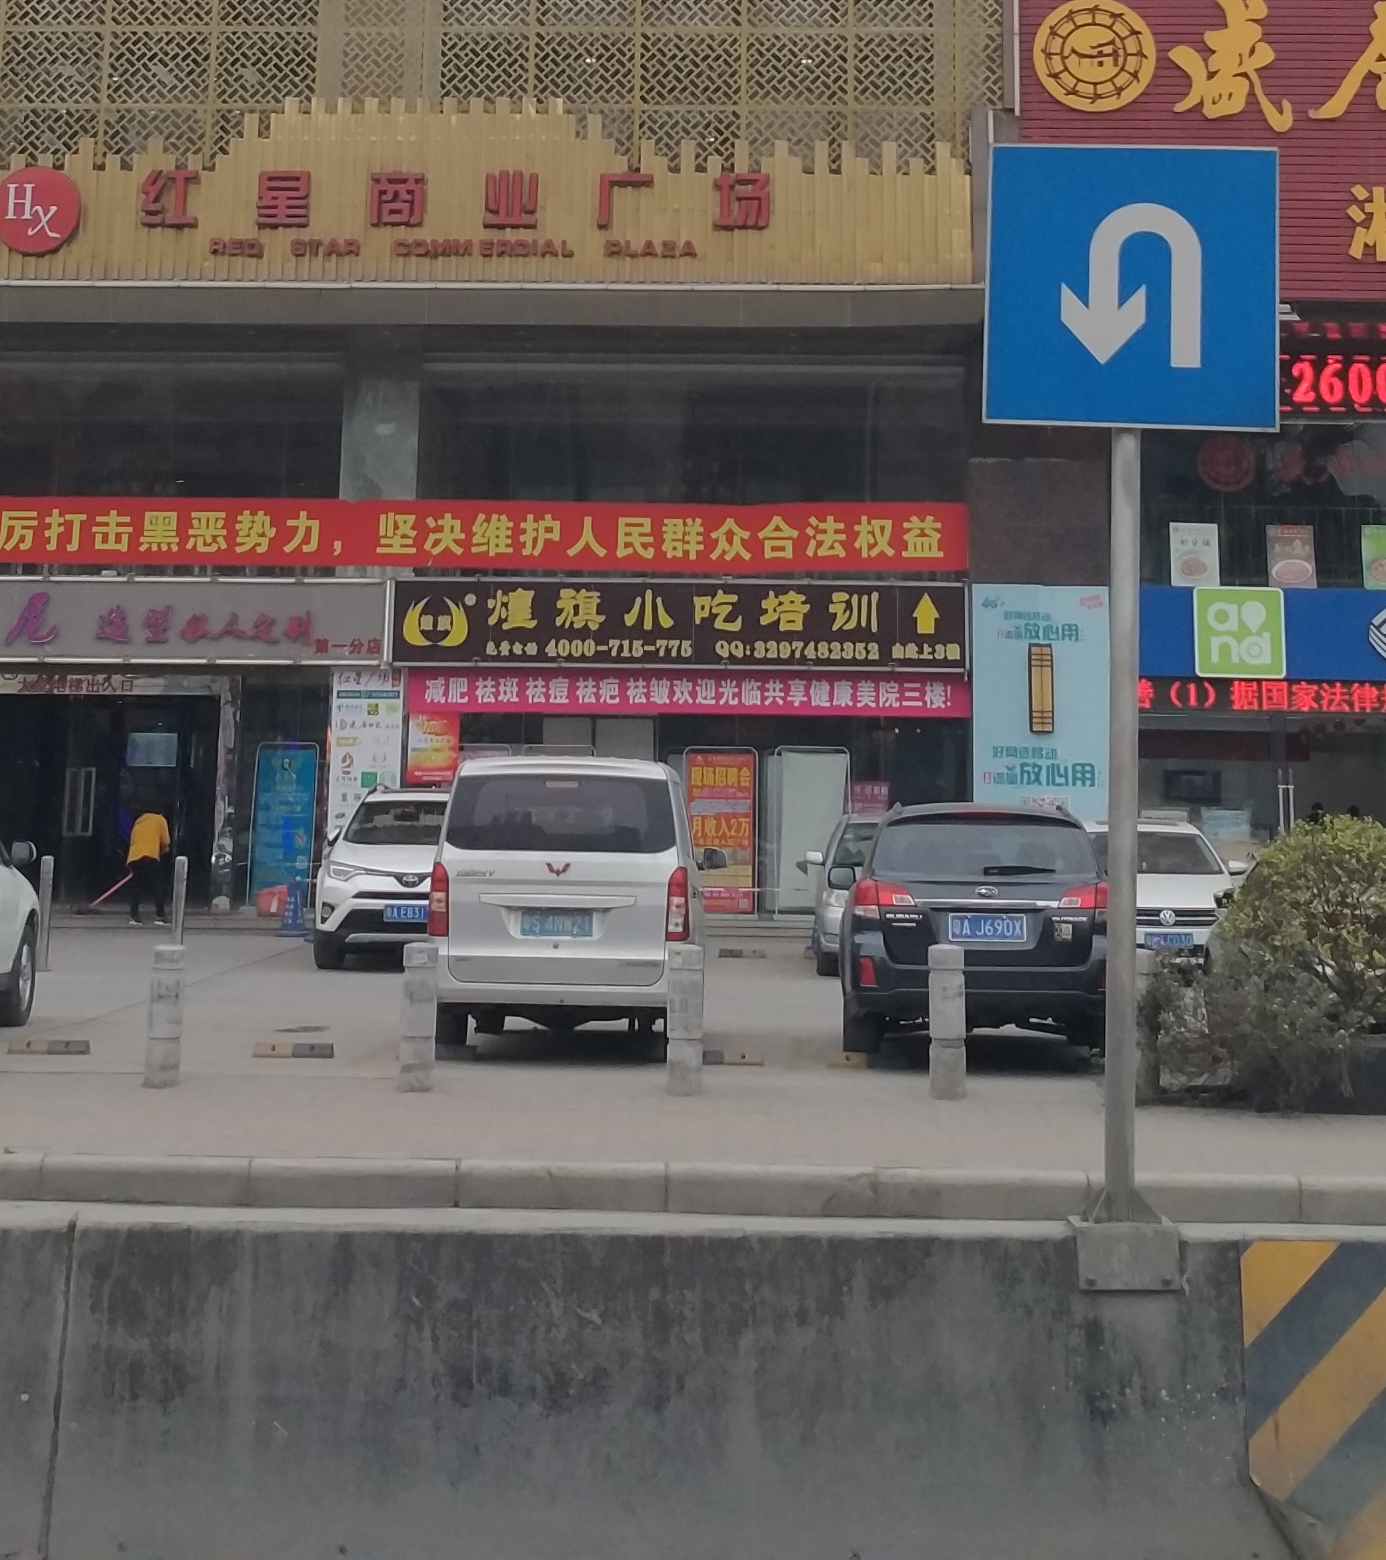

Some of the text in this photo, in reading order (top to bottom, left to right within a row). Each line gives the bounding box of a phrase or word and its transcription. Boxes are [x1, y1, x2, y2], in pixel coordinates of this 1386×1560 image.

[140, 168, 774, 231] 红星商业广场
[209, 238, 265, 259] RED
[289, 238, 362, 258] STAR
[607, 238, 698, 259] PLAZA
[377, 512, 944, 561] 坚决维护人民群众合法权益
[545, 638, 692, 659] 4000-715-775
[715, 641, 880, 661] QQ:3297482352
[424, 678, 468, 704] 减肥
[475, 678, 519, 704] 祛斑
[525, 678, 570, 705] 祛痘
[576, 679, 620, 705] 祛疤
[691, 766, 751, 787] 现场招聘会
[691, 816, 751, 838] 月收入2万
